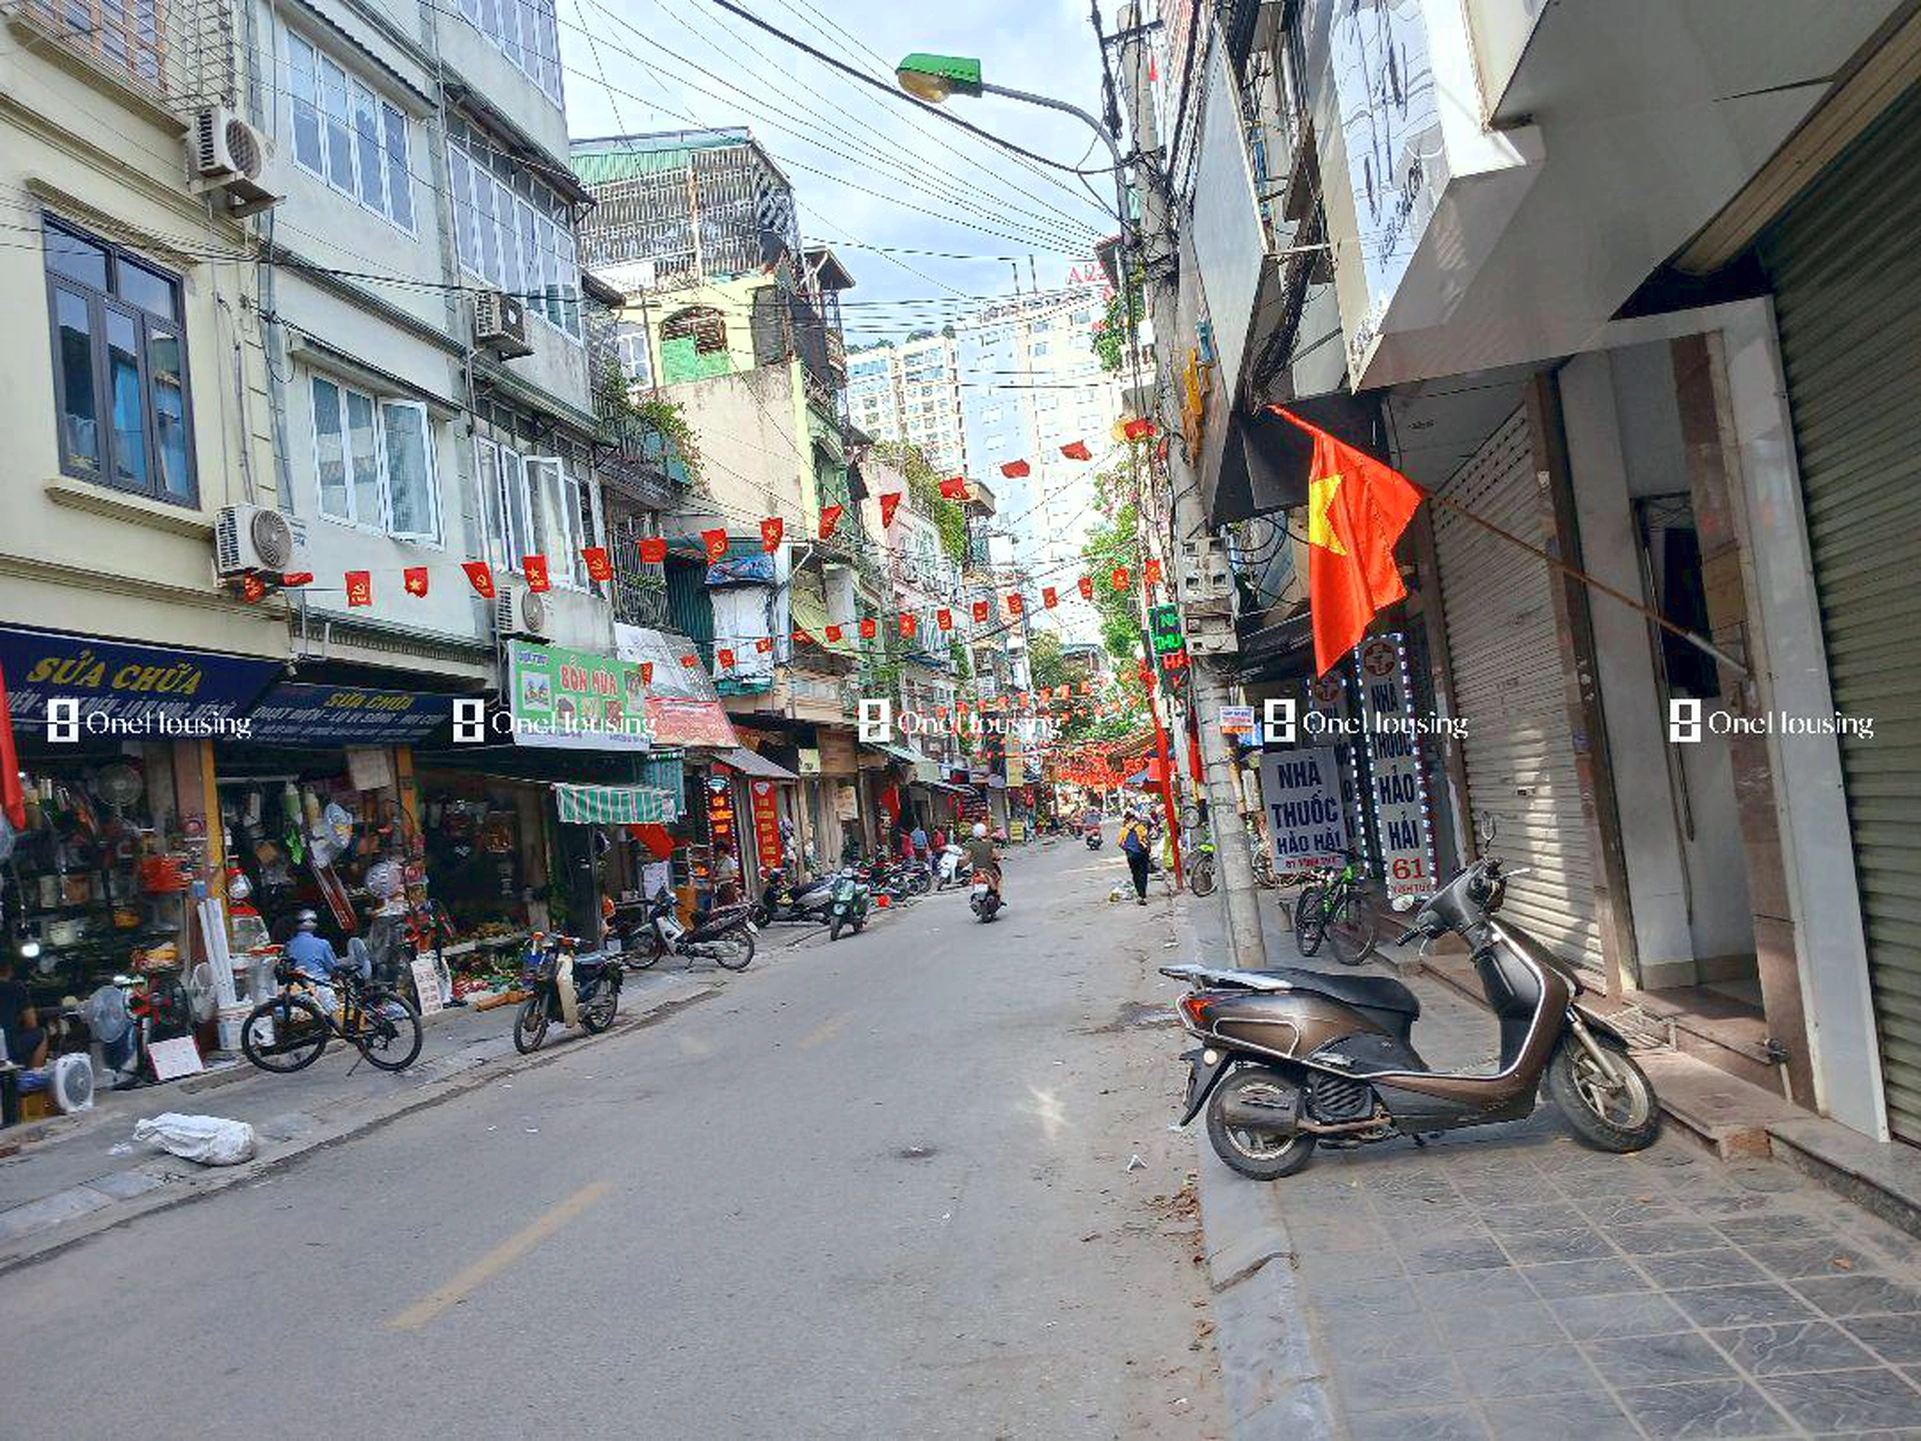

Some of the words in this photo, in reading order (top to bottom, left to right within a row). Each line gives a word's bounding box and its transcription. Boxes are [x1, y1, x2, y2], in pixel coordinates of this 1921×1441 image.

[27, 649, 106, 687] SỬA
[111, 661, 202, 695] CHỮA
[560, 654, 588, 692] BỐN
[591, 664, 618, 696] MÙA
[1277, 756, 1322, 790] NHÀ
[1271, 790, 1339, 829] THUỐC
[1393, 857, 1427, 880] 61
